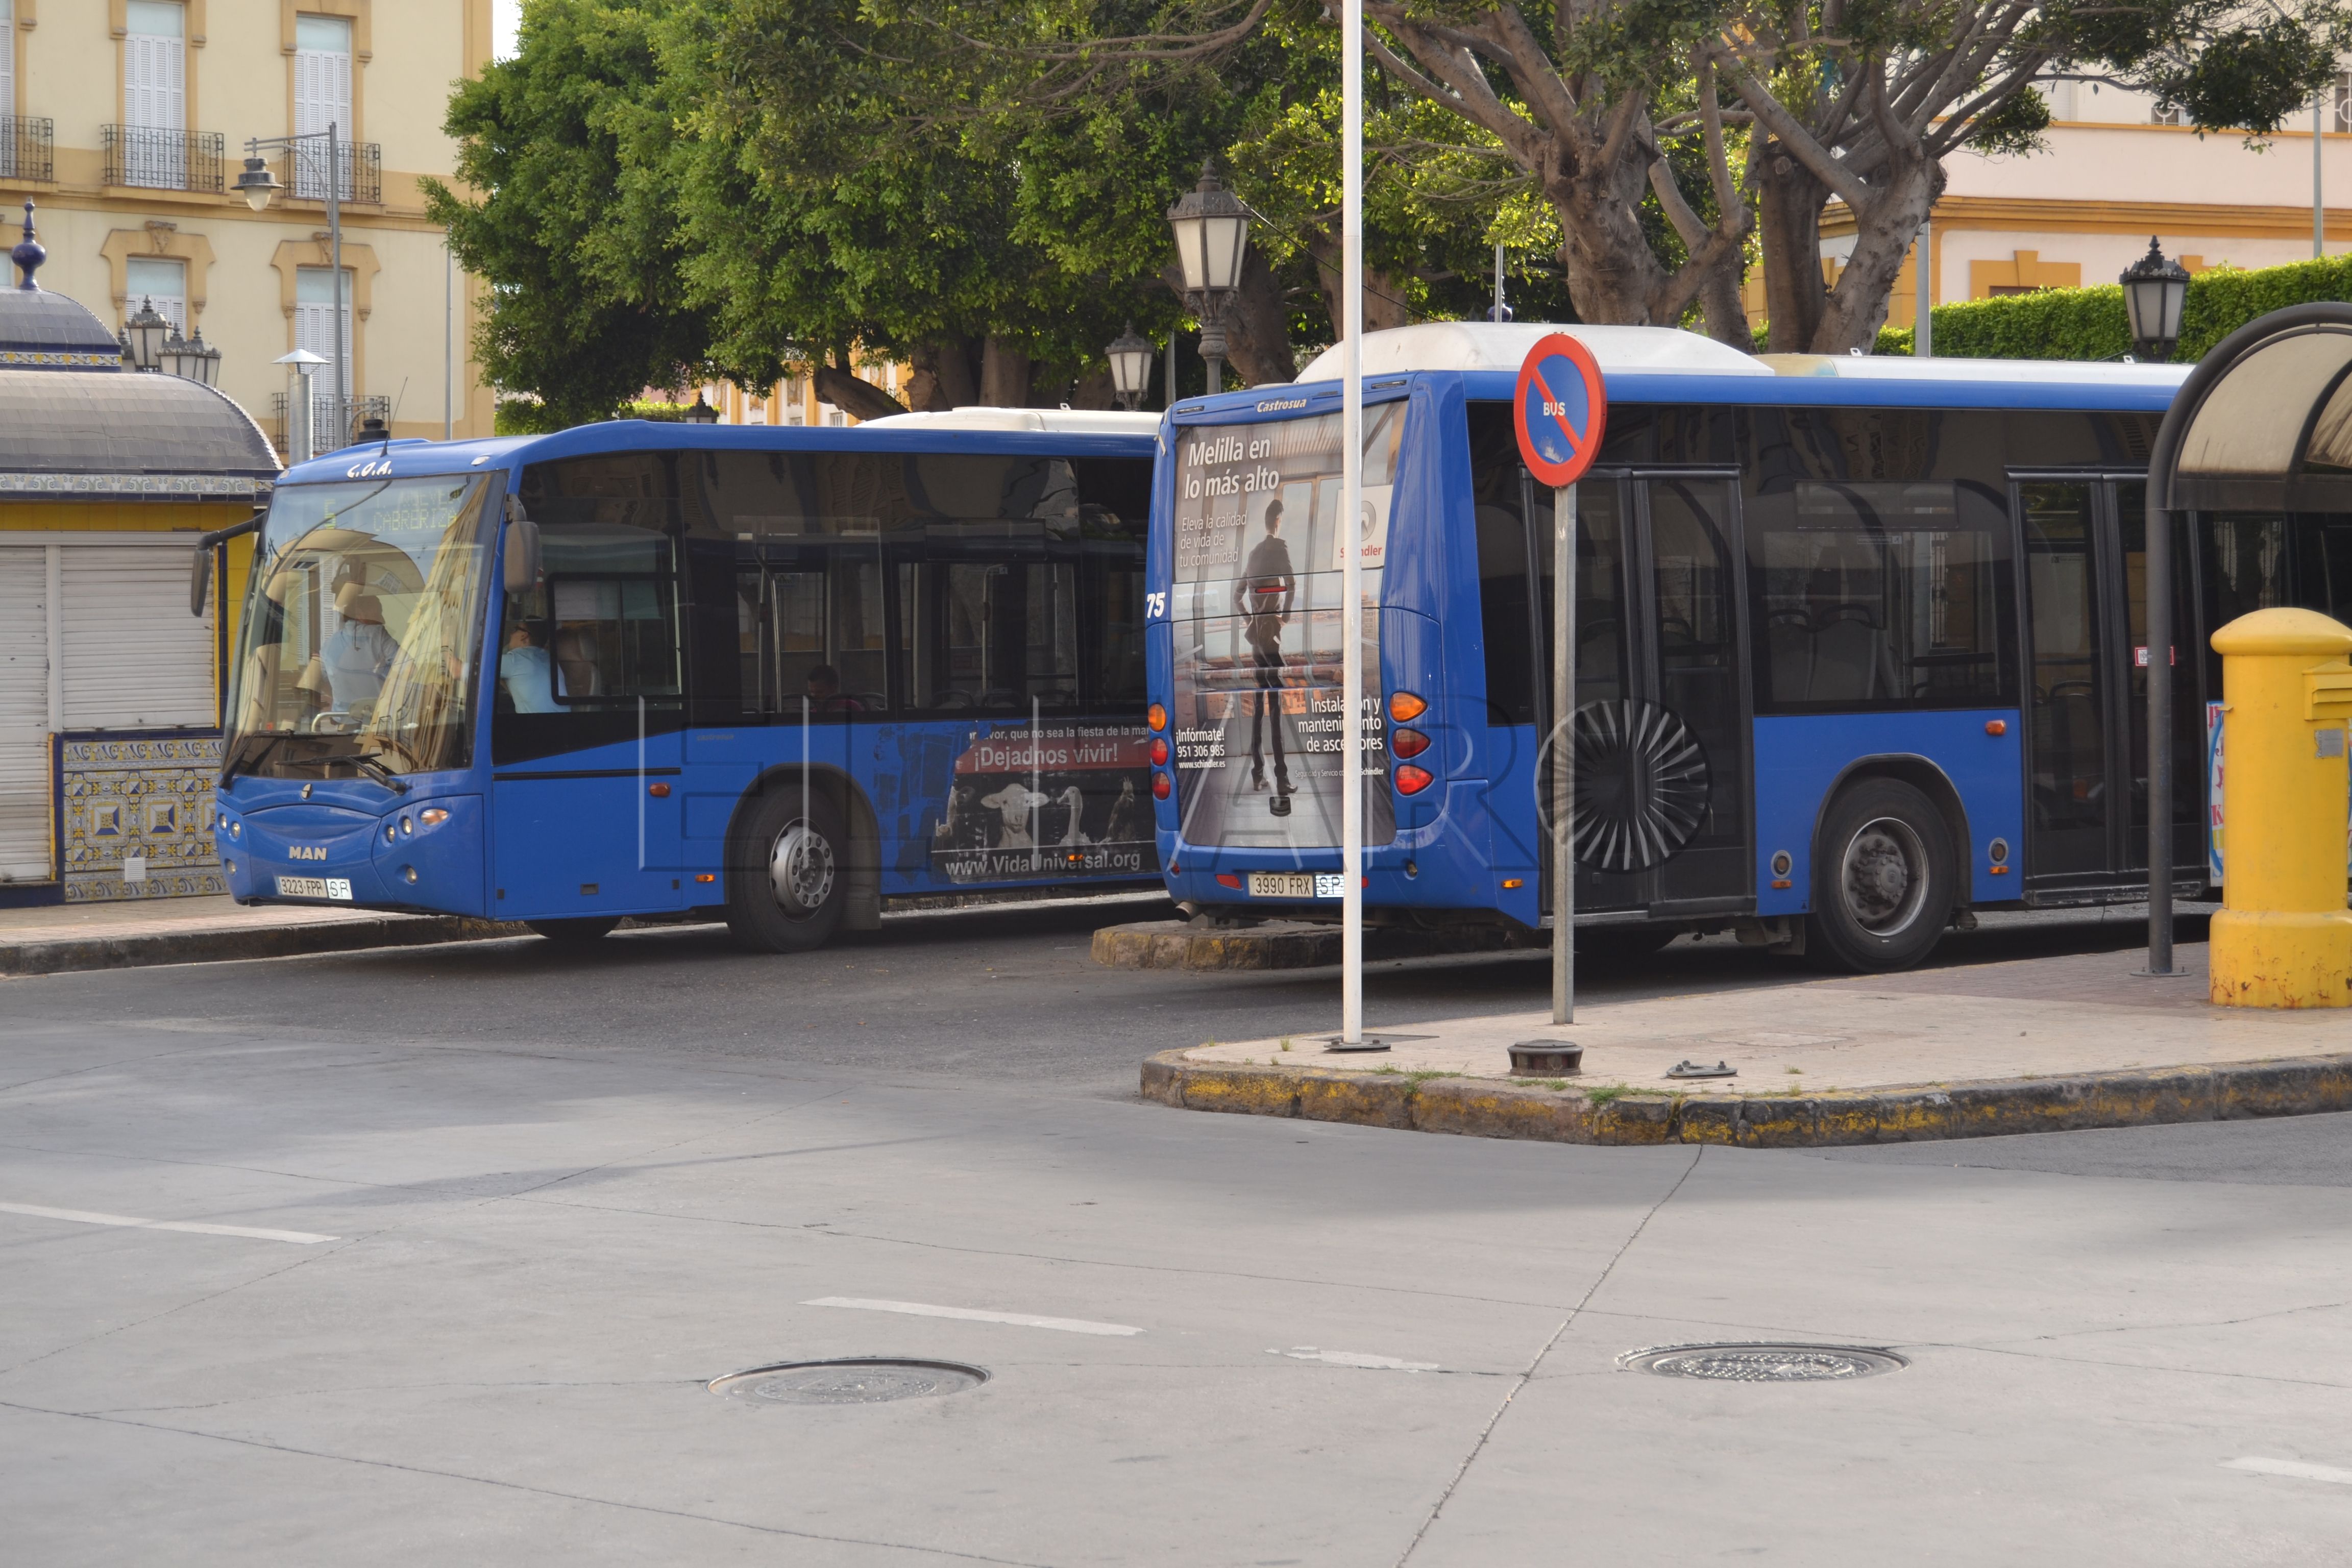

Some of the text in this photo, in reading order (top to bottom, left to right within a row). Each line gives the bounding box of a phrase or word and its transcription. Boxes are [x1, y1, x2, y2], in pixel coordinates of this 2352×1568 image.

[1257, 398, 1307, 412] Castrosua
[1544, 402, 1565, 416] BUS
[1188, 436, 1270, 467] Melilla en
[347, 460, 392, 478] C.O.A.
[1185, 465, 1280, 499] lo más alto
[1182, 510, 1247, 531] Eleva la calidad
[1181, 531, 1224, 549] de vida de
[1180, 547, 1239, 567] tu comunidad
[1147, 592, 1165, 619] 75
[1373, 698, 1380, 715] y
[1011, 730, 1028, 741] que
[1032, 730, 1044, 739] no
[1046, 729, 1064, 738] sea
[1066, 727, 1075, 738] la
[1077, 726, 1103, 737] fiesta
[1107, 726, 1118, 736] de
[1121, 725, 1129, 736] la
[1175, 727, 1224, 745] ¡Infórmate!
[1177, 744, 1225, 757] 951 306 985
[1307, 736, 1320, 752] de
[975, 743, 1118, 771] ¡Dejadnos vivir!
[1178, 759, 1226, 769] www.schindler.es
[289, 846, 327, 861] MAN
[945, 851, 1140, 876] www.VidaUniversal.org
[281, 879, 304, 894] 3223
[1256, 877, 1310, 894] 3990 FRX
[1319, 877, 1340, 894] SP
